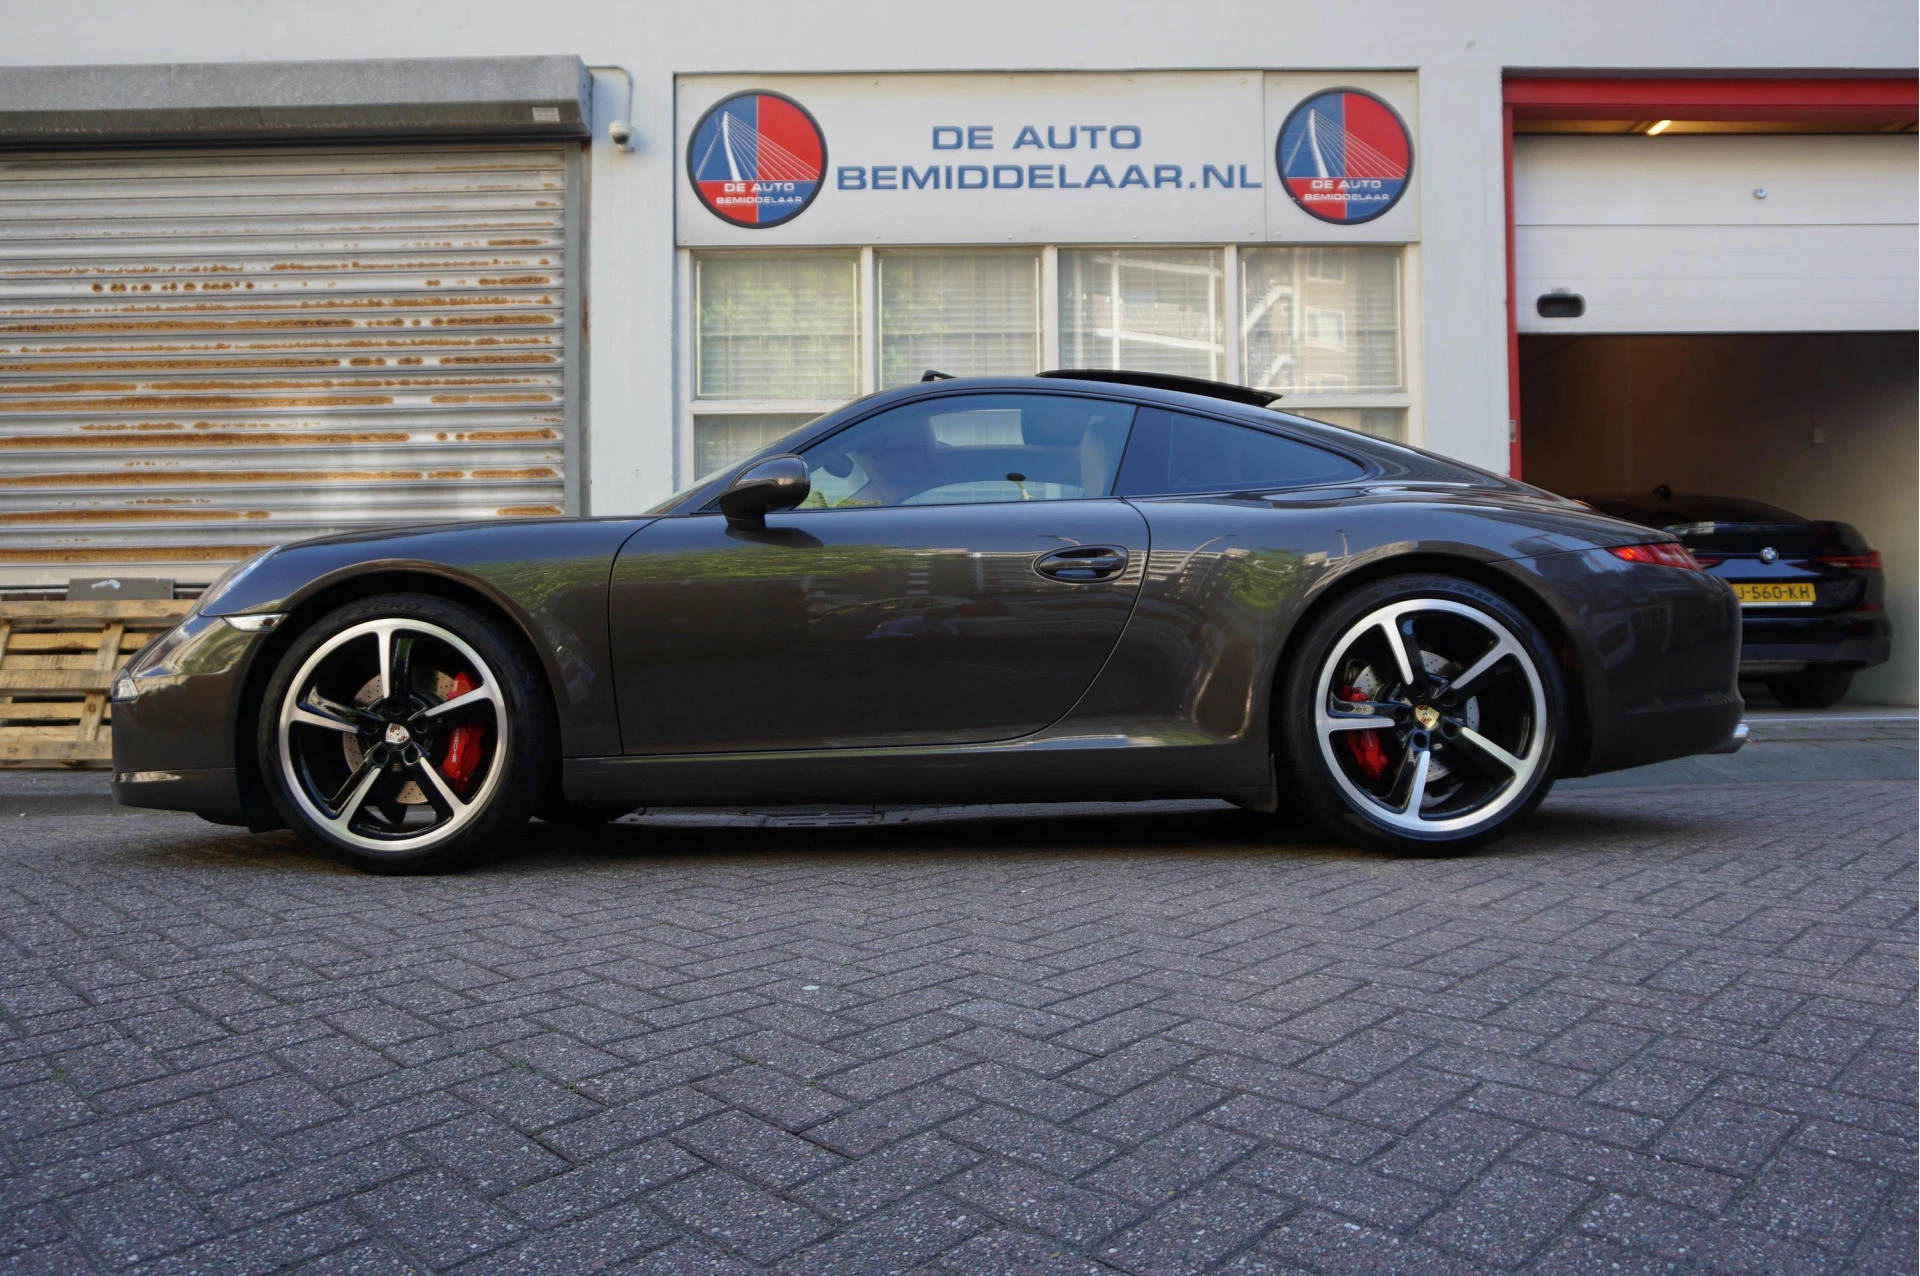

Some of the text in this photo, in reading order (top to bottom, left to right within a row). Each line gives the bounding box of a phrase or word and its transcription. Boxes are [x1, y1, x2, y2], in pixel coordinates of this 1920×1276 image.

[932, 124, 1142, 150] DE AUTO
[837, 164, 1263, 190] BEMIDDELAAR.NL
[724, 182, 795, 192] DE AUTO
[1311, 179, 1382, 189] DE AUTO
[716, 196, 803, 204] BEMIDDELAAR
[1304, 193, 1390, 201] BEMIDDELAAR
